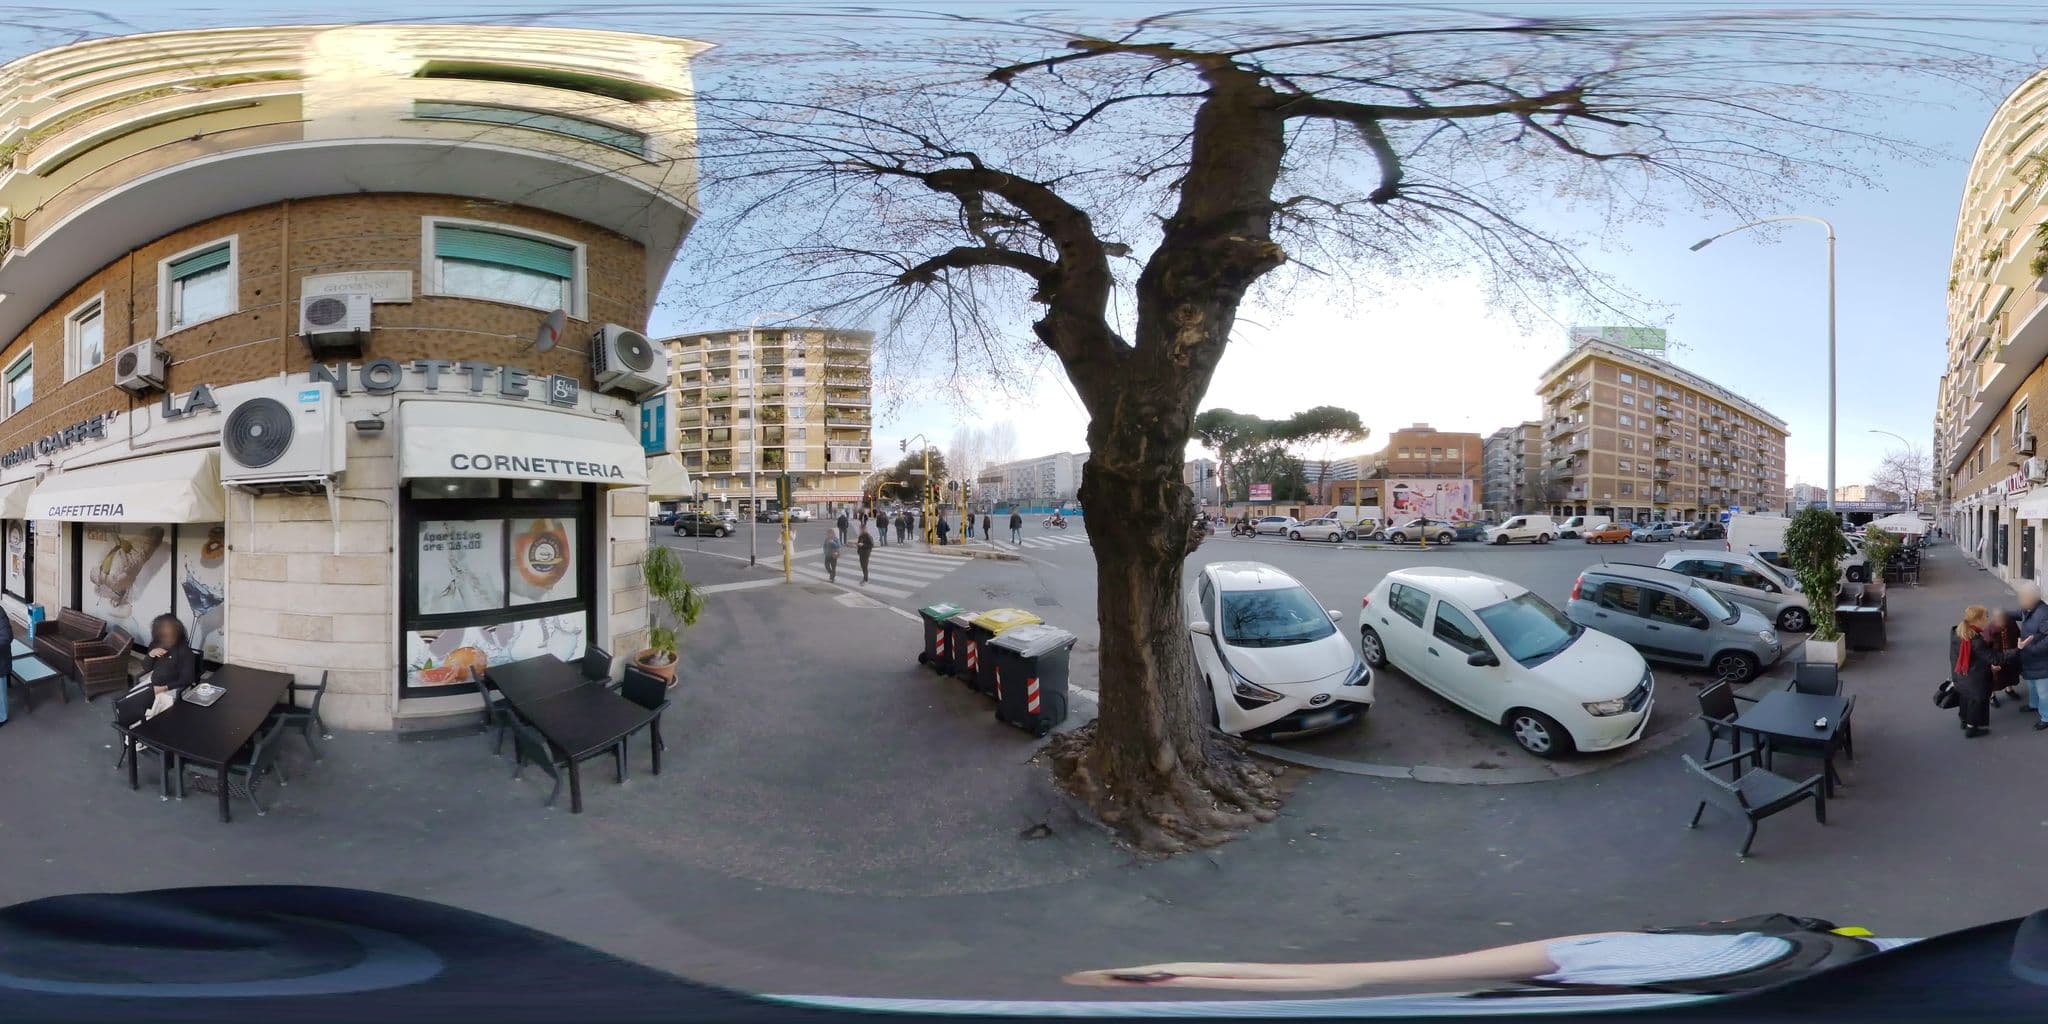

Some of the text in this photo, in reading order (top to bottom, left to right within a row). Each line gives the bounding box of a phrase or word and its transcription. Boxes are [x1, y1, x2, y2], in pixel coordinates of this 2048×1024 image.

[162, 383, 216, 418] LA
[309, 358, 530, 399] NOTTE
[450, 453, 625, 479] CORNETTERIA
[48, 503, 125, 517] CAFFETTERIA
